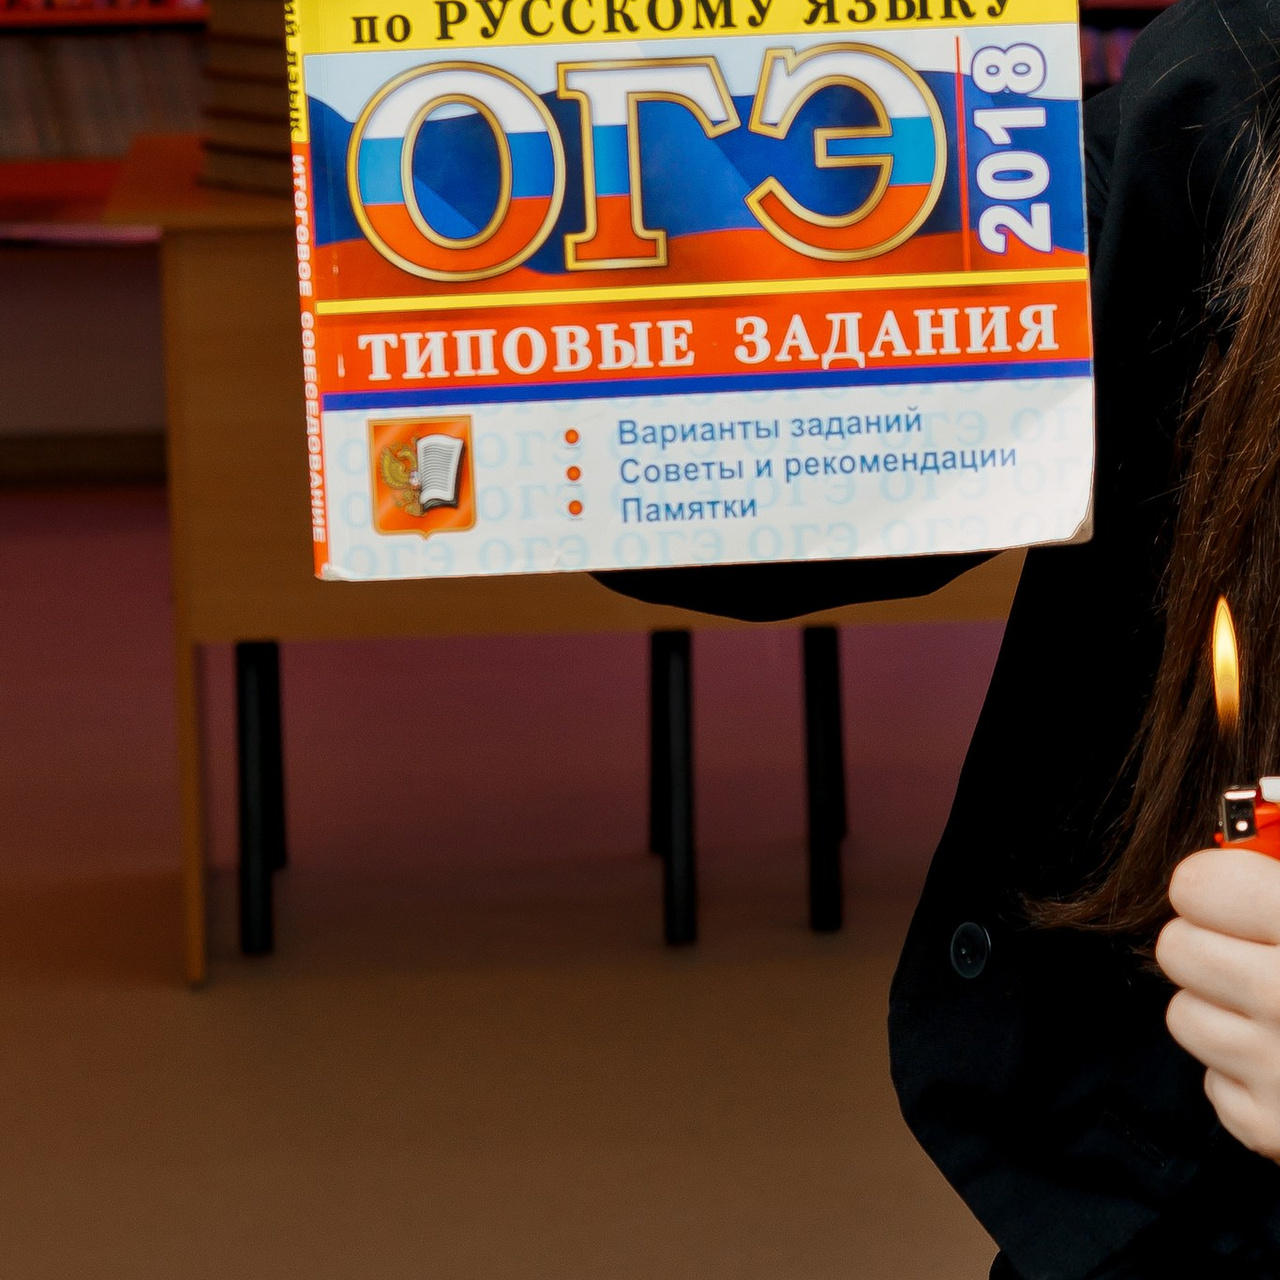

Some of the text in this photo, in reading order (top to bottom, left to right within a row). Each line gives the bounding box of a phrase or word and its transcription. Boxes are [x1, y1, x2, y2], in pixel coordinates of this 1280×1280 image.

[351, 14, 411, 45] по
[346, 41, 949, 282] ОГЭ
[971, 43, 1052, 254] 2018
[292, 154, 326, 543] ИТОГОВОЕ СОБЕСЕДОВАНИЕ
[358, 303, 1060, 382] ТИПОВЫЕ ЗАДАНИЯ
[617, 406, 923, 451] Варианты заданий
[618, 447, 1018, 485] Советы и рекомендации
[621, 495, 758, 524] Памятки
